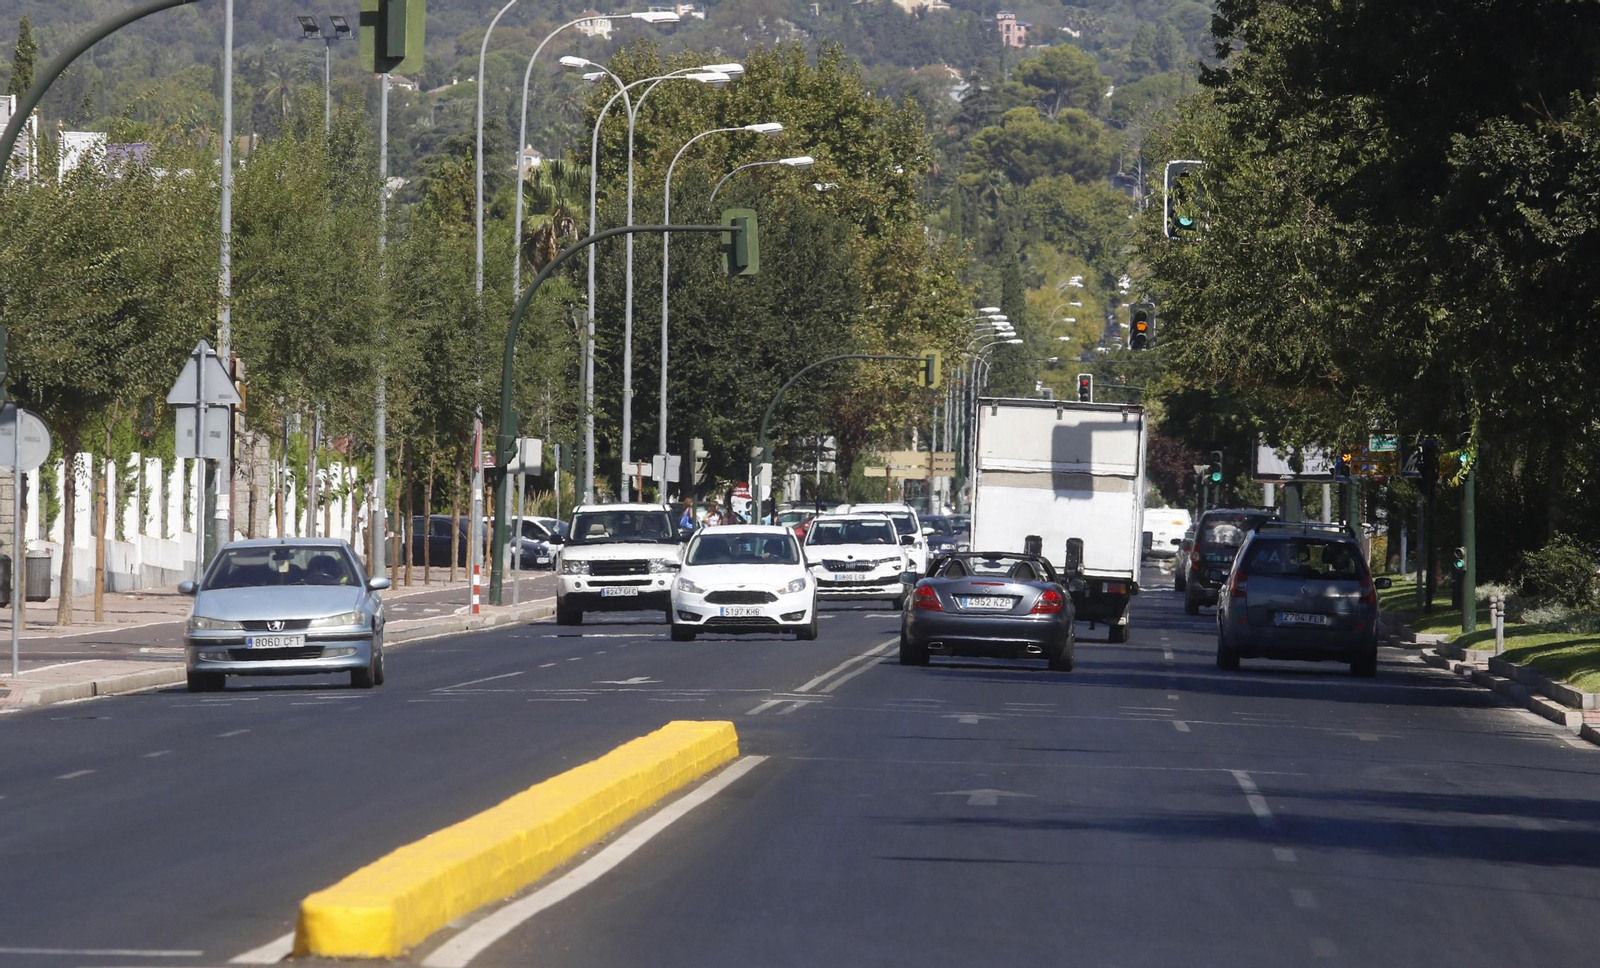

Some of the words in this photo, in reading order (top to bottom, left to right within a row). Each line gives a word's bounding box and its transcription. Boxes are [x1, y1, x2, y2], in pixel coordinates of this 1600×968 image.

[969, 597, 991, 606] 4952
[993, 598, 1011, 607] KZP
[1283, 612, 1305, 621] 2704
[1308, 615, 1325, 624] FLR
[255, 637, 280, 647] 8060
[284, 636, 301, 646] CFT
